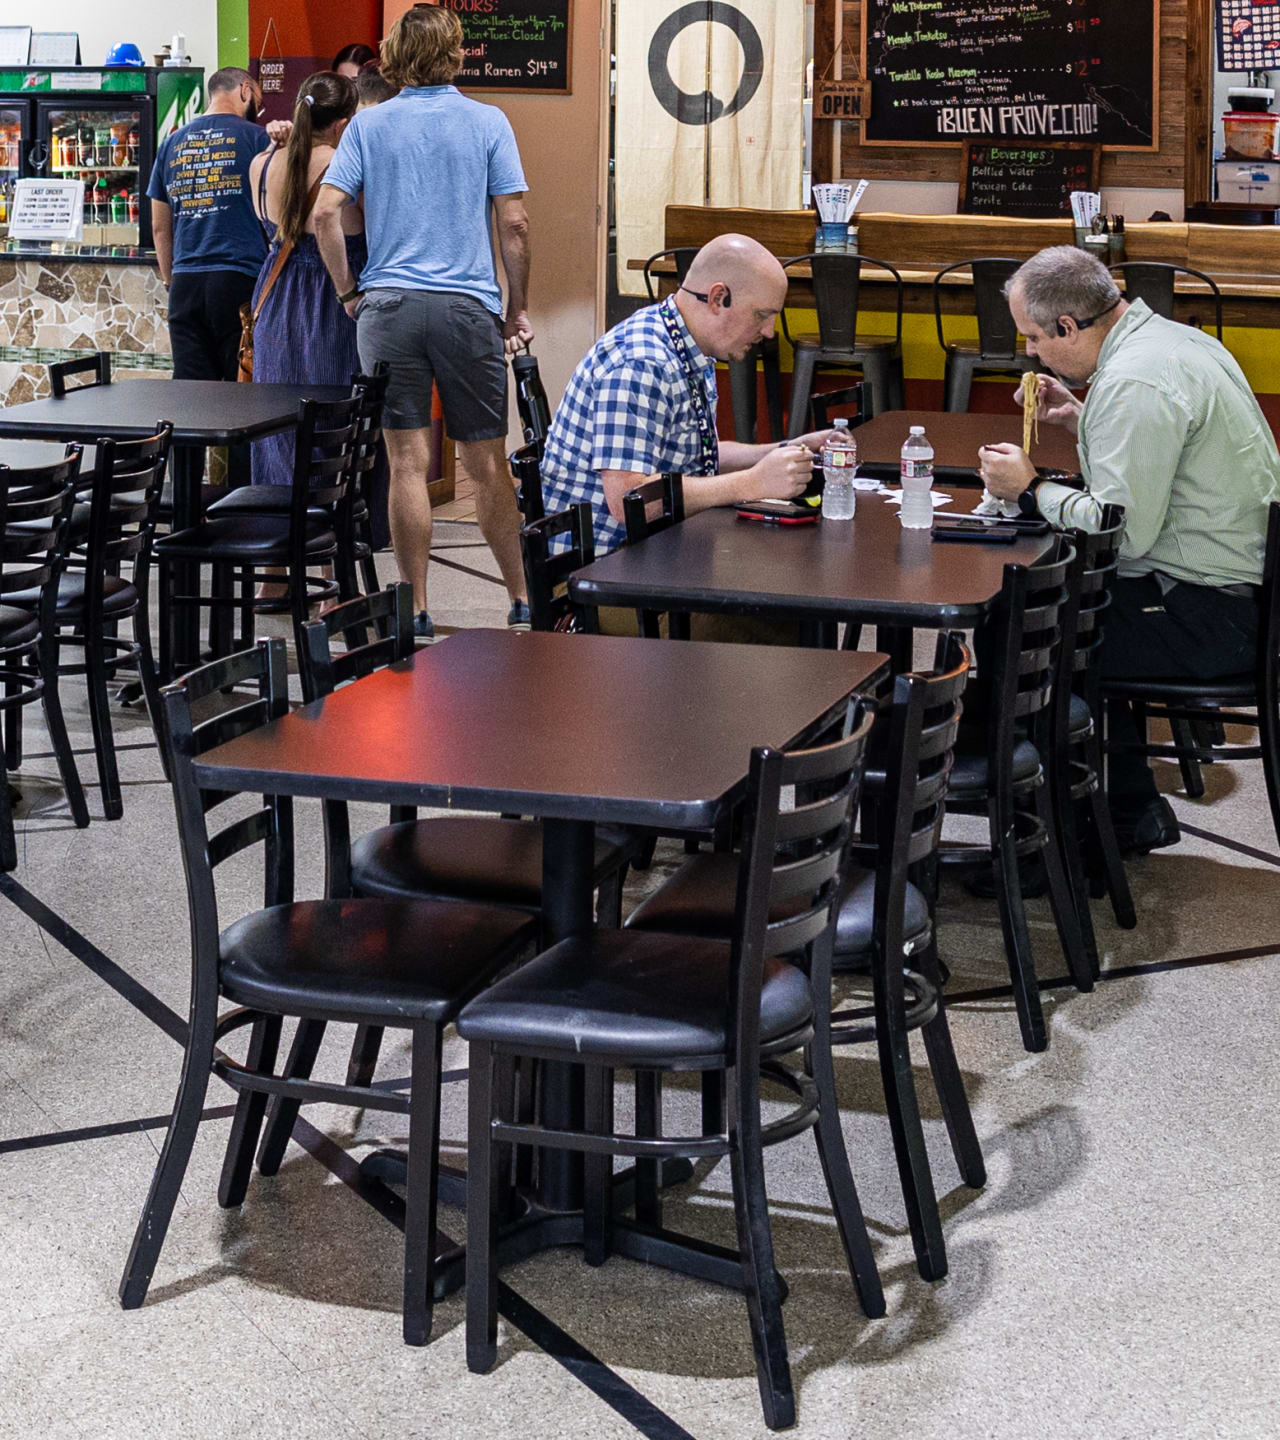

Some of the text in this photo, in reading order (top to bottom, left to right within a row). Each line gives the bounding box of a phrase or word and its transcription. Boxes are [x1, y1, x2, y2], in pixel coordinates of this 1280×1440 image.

[512, 30, 544, 41] Closed
[261, 63, 284, 74] ORDER
[457, 66, 480, 76] irria
[485, 62, 521, 77] Ramen
[263, 80, 280, 90] HERE
[823, 95, 861, 115] OPEN
[937, 104, 1098, 134] ¡BUEN PROVECHO!
[991, 148, 1046, 162] Beverages
[972, 182, 1007, 190] Mexican
